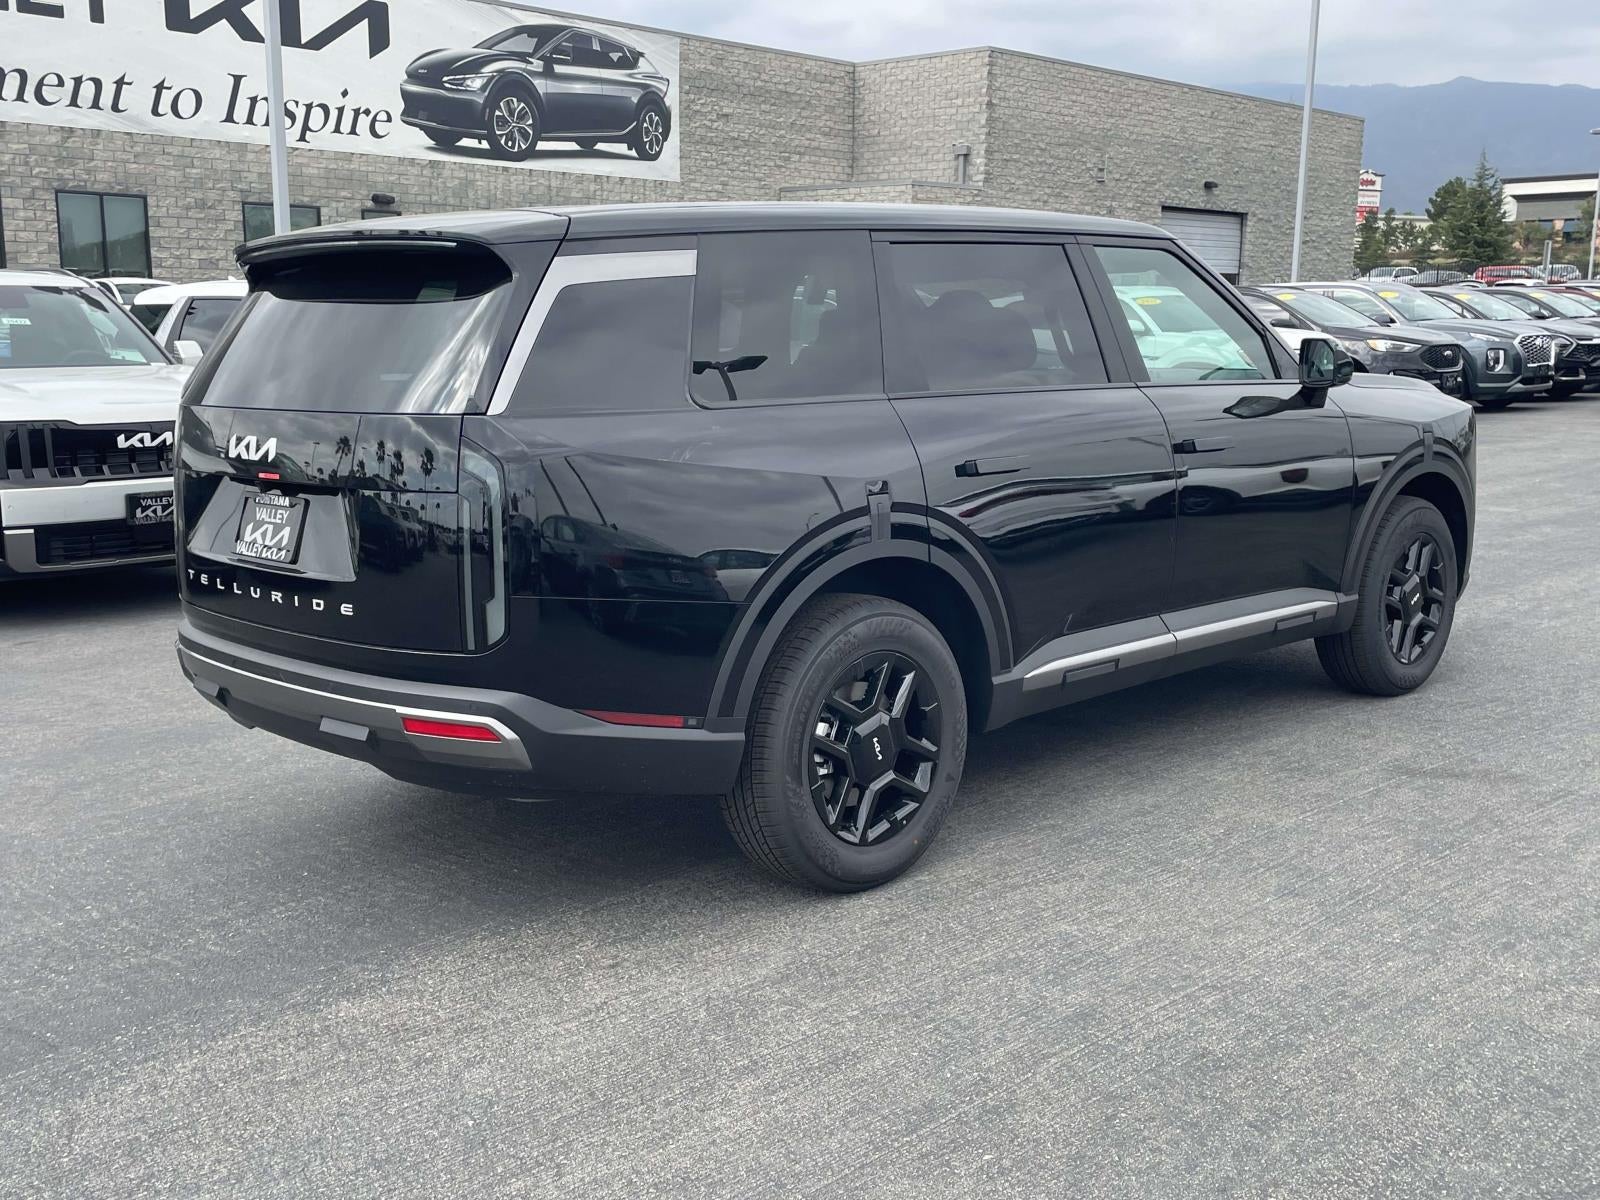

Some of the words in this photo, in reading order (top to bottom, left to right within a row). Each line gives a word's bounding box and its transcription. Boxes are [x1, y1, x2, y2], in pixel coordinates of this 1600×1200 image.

[151, 77, 203, 120] to
[219, 72, 393, 143] Inspire
[228, 433, 277, 462] KIA
[140, 496, 174, 506] VALLEY
[256, 507, 290, 524] VALLEY
[244, 522, 291, 548] KIA
[236, 540, 263, 558] VALLEY
[187, 569, 354, 616] TELLURIDE
